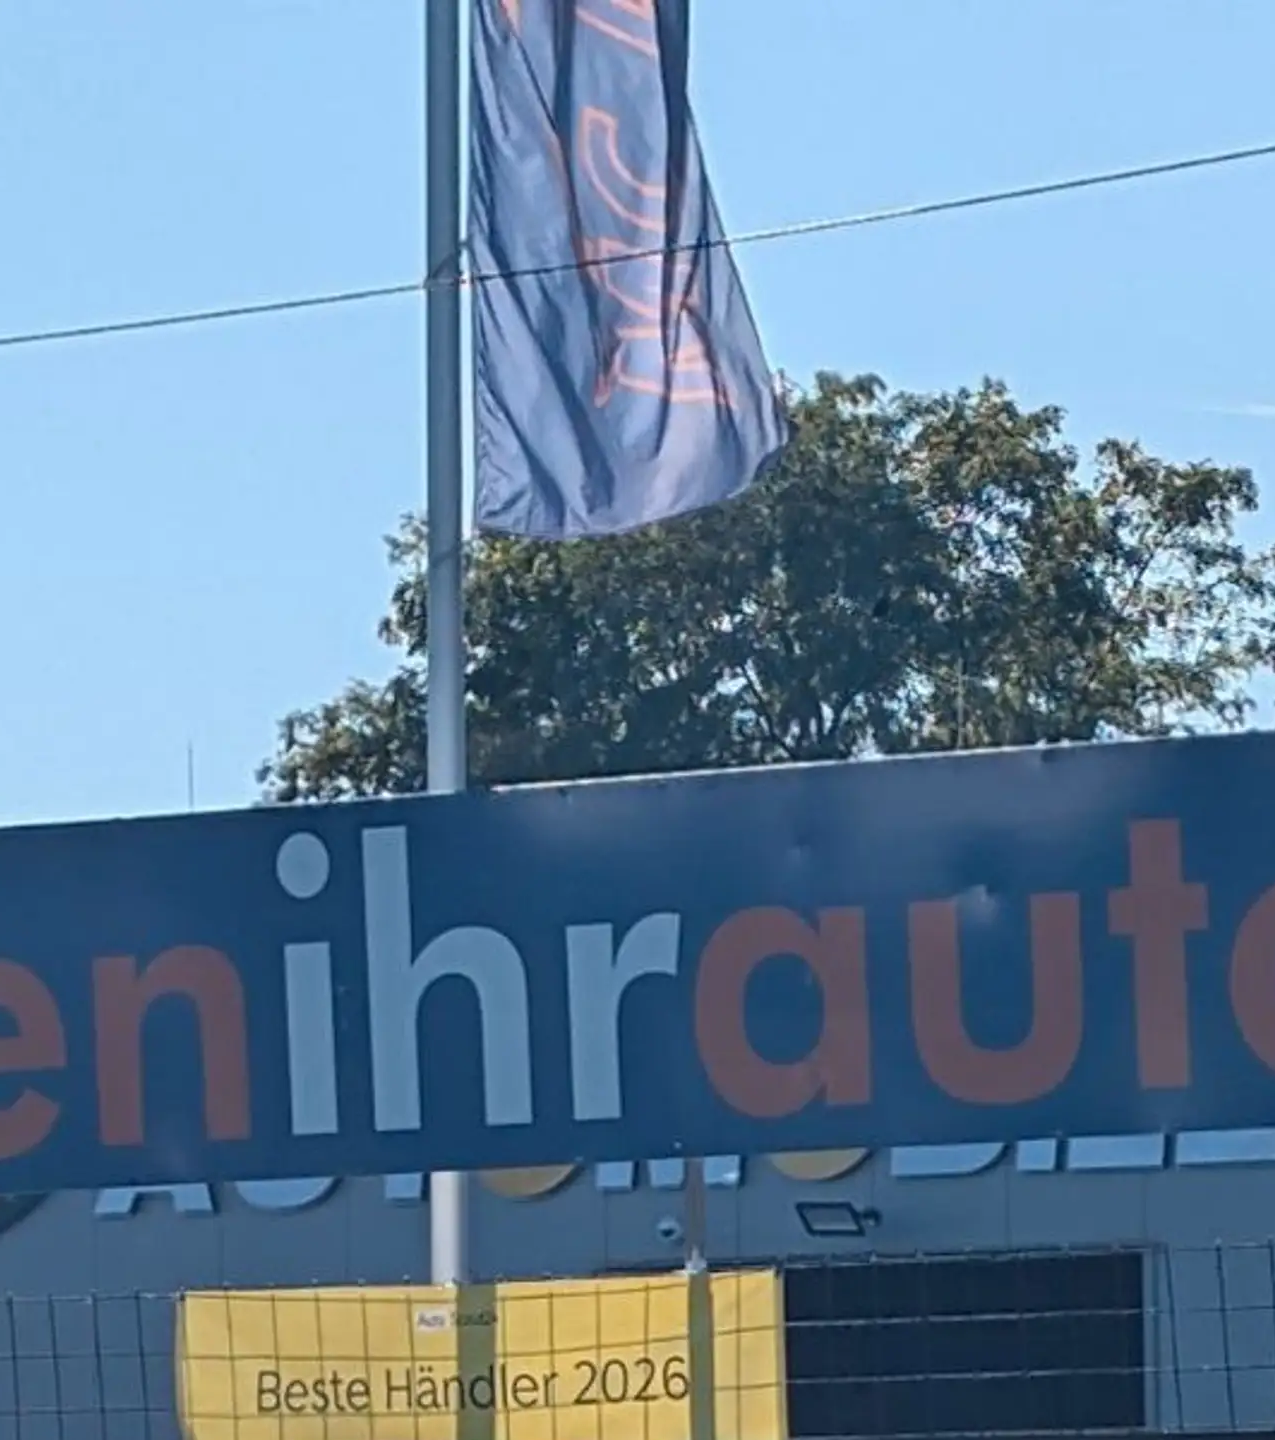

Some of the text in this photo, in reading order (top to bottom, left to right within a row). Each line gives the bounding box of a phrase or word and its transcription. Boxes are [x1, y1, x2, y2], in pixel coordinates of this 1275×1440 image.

[256, 1355, 691, 1414] Beste Händler 2026
